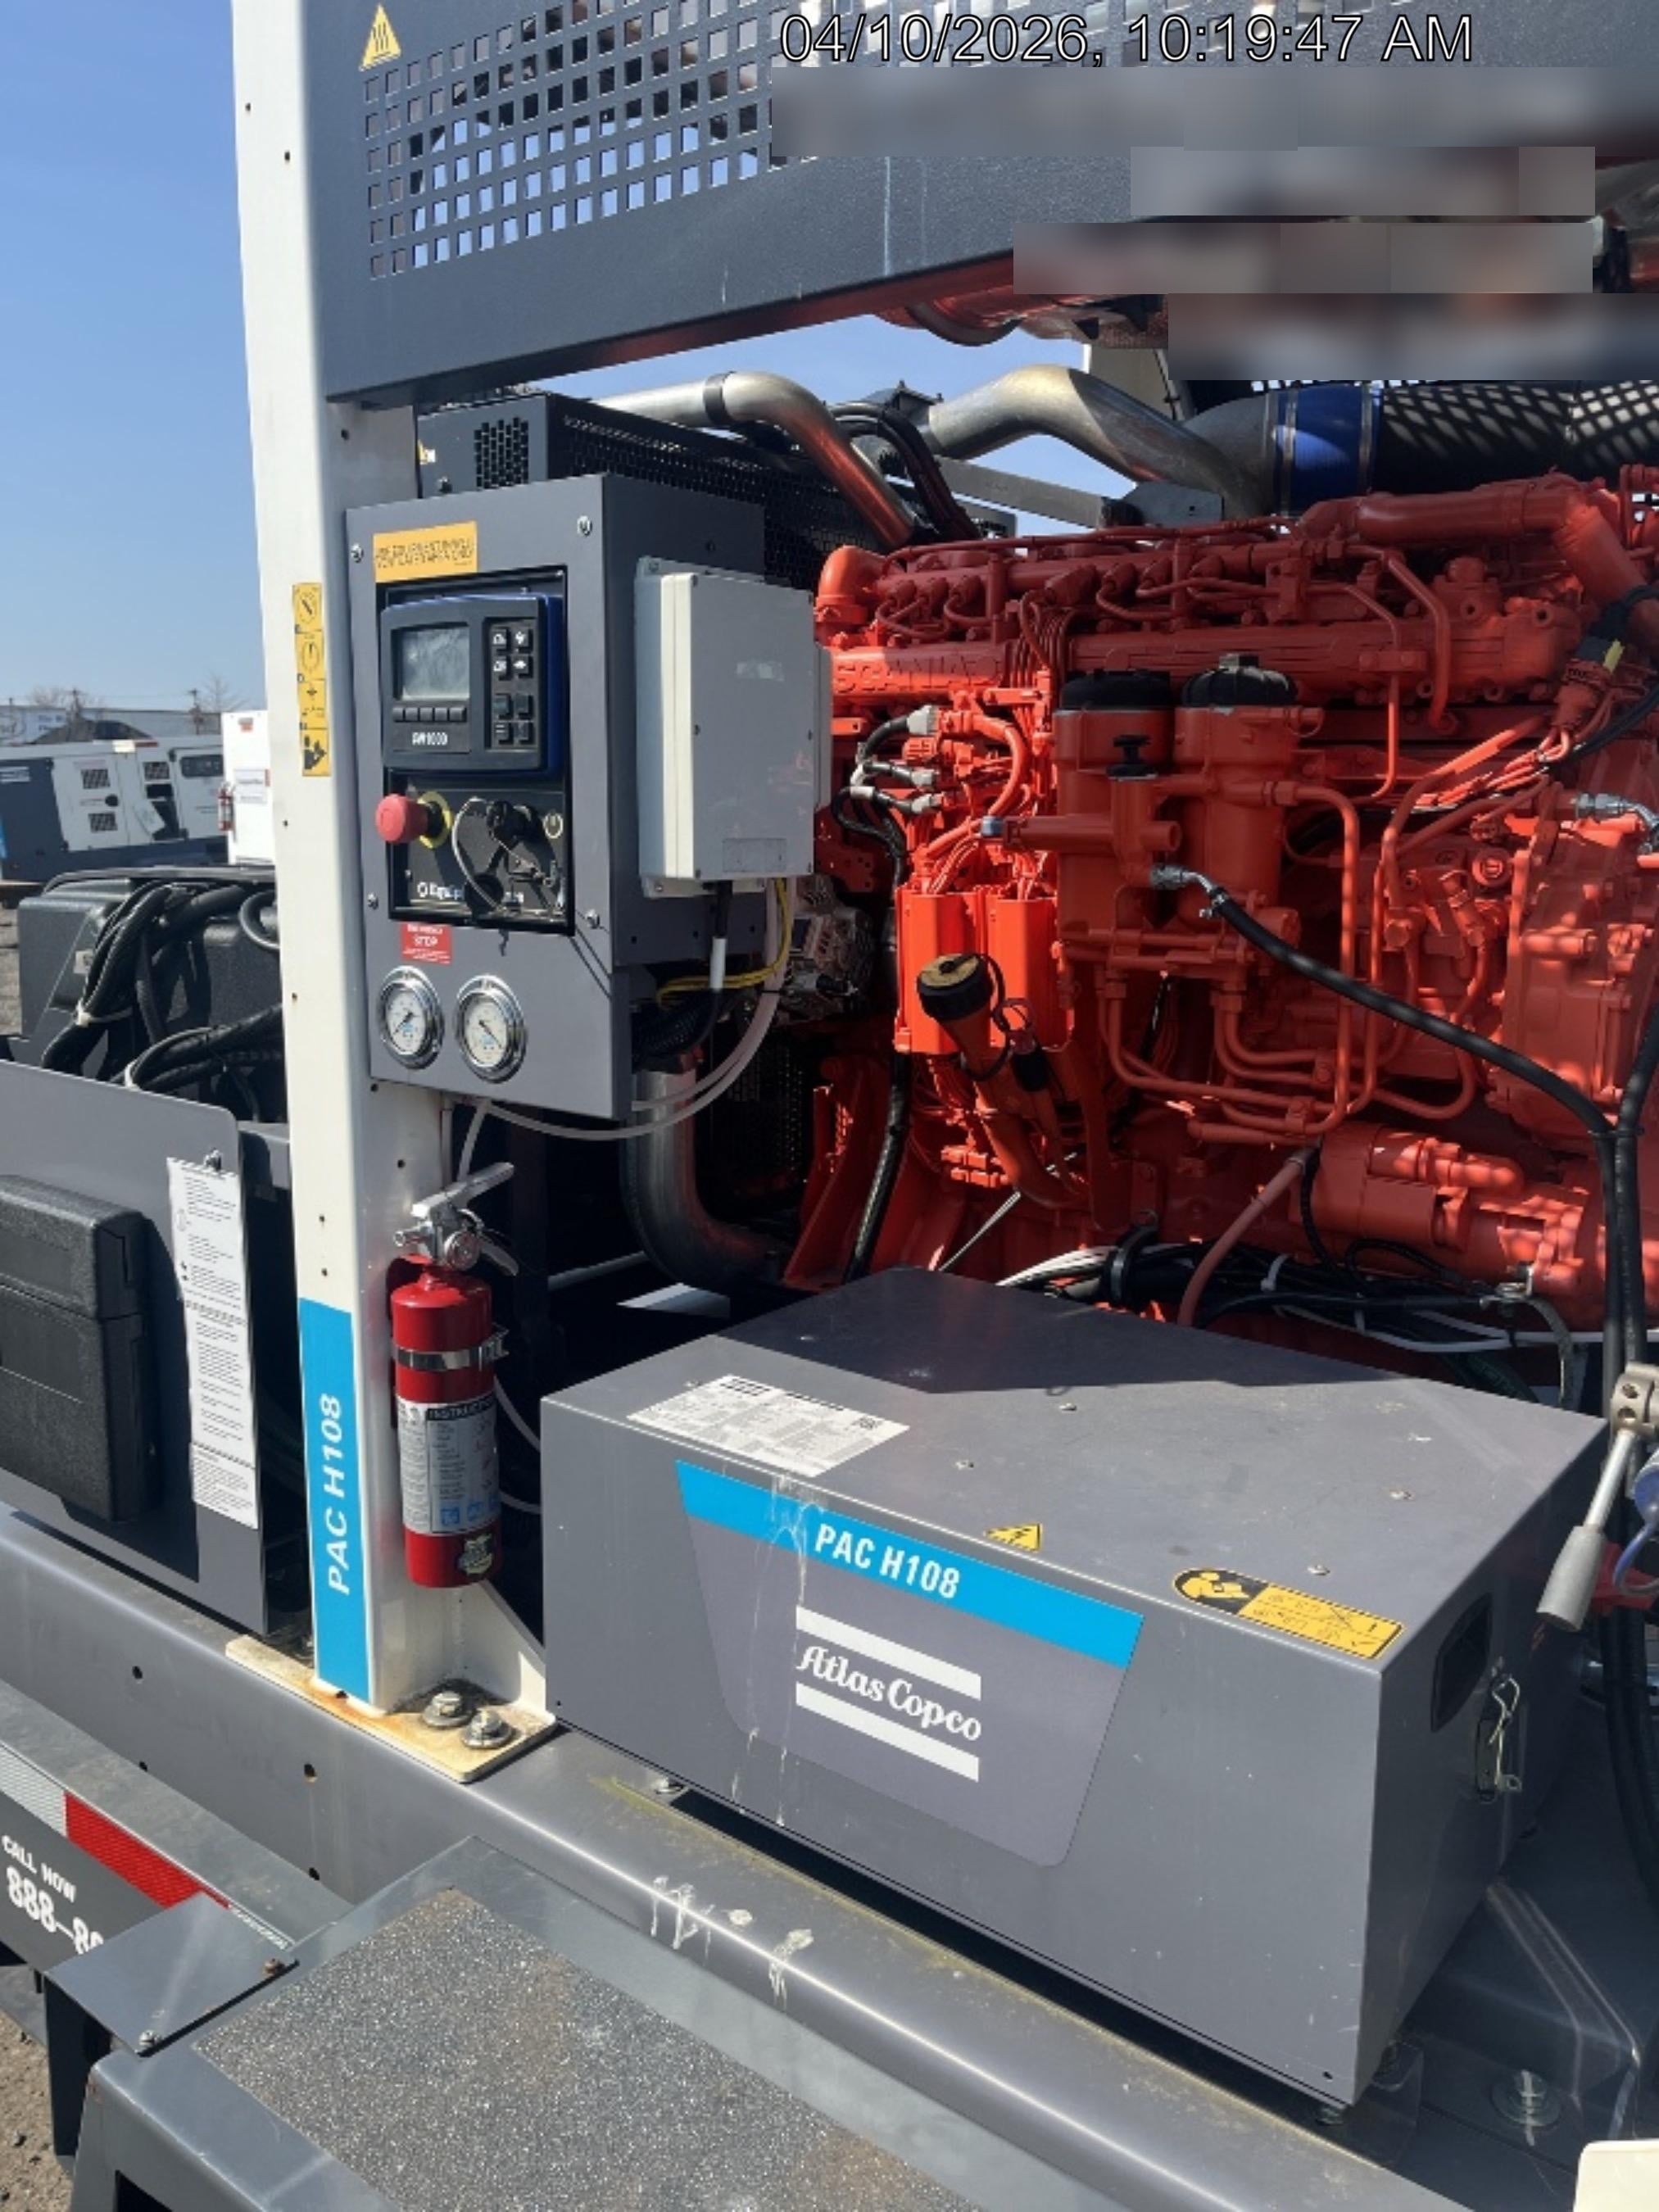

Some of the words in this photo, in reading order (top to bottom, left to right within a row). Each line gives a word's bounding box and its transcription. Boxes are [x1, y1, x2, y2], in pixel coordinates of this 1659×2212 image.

[320, 1393, 346, 1499] H108
[326, 1507, 350, 1596] PAC
[814, 1523, 876, 1570] PAC
[879, 1545, 960, 1598] H108
[796, 1645, 886, 1702] Atlas
[887, 1678, 981, 1741] Copco
[2, 1834, 37, 1874] CALL
[41, 1862, 77, 1903] NOW
